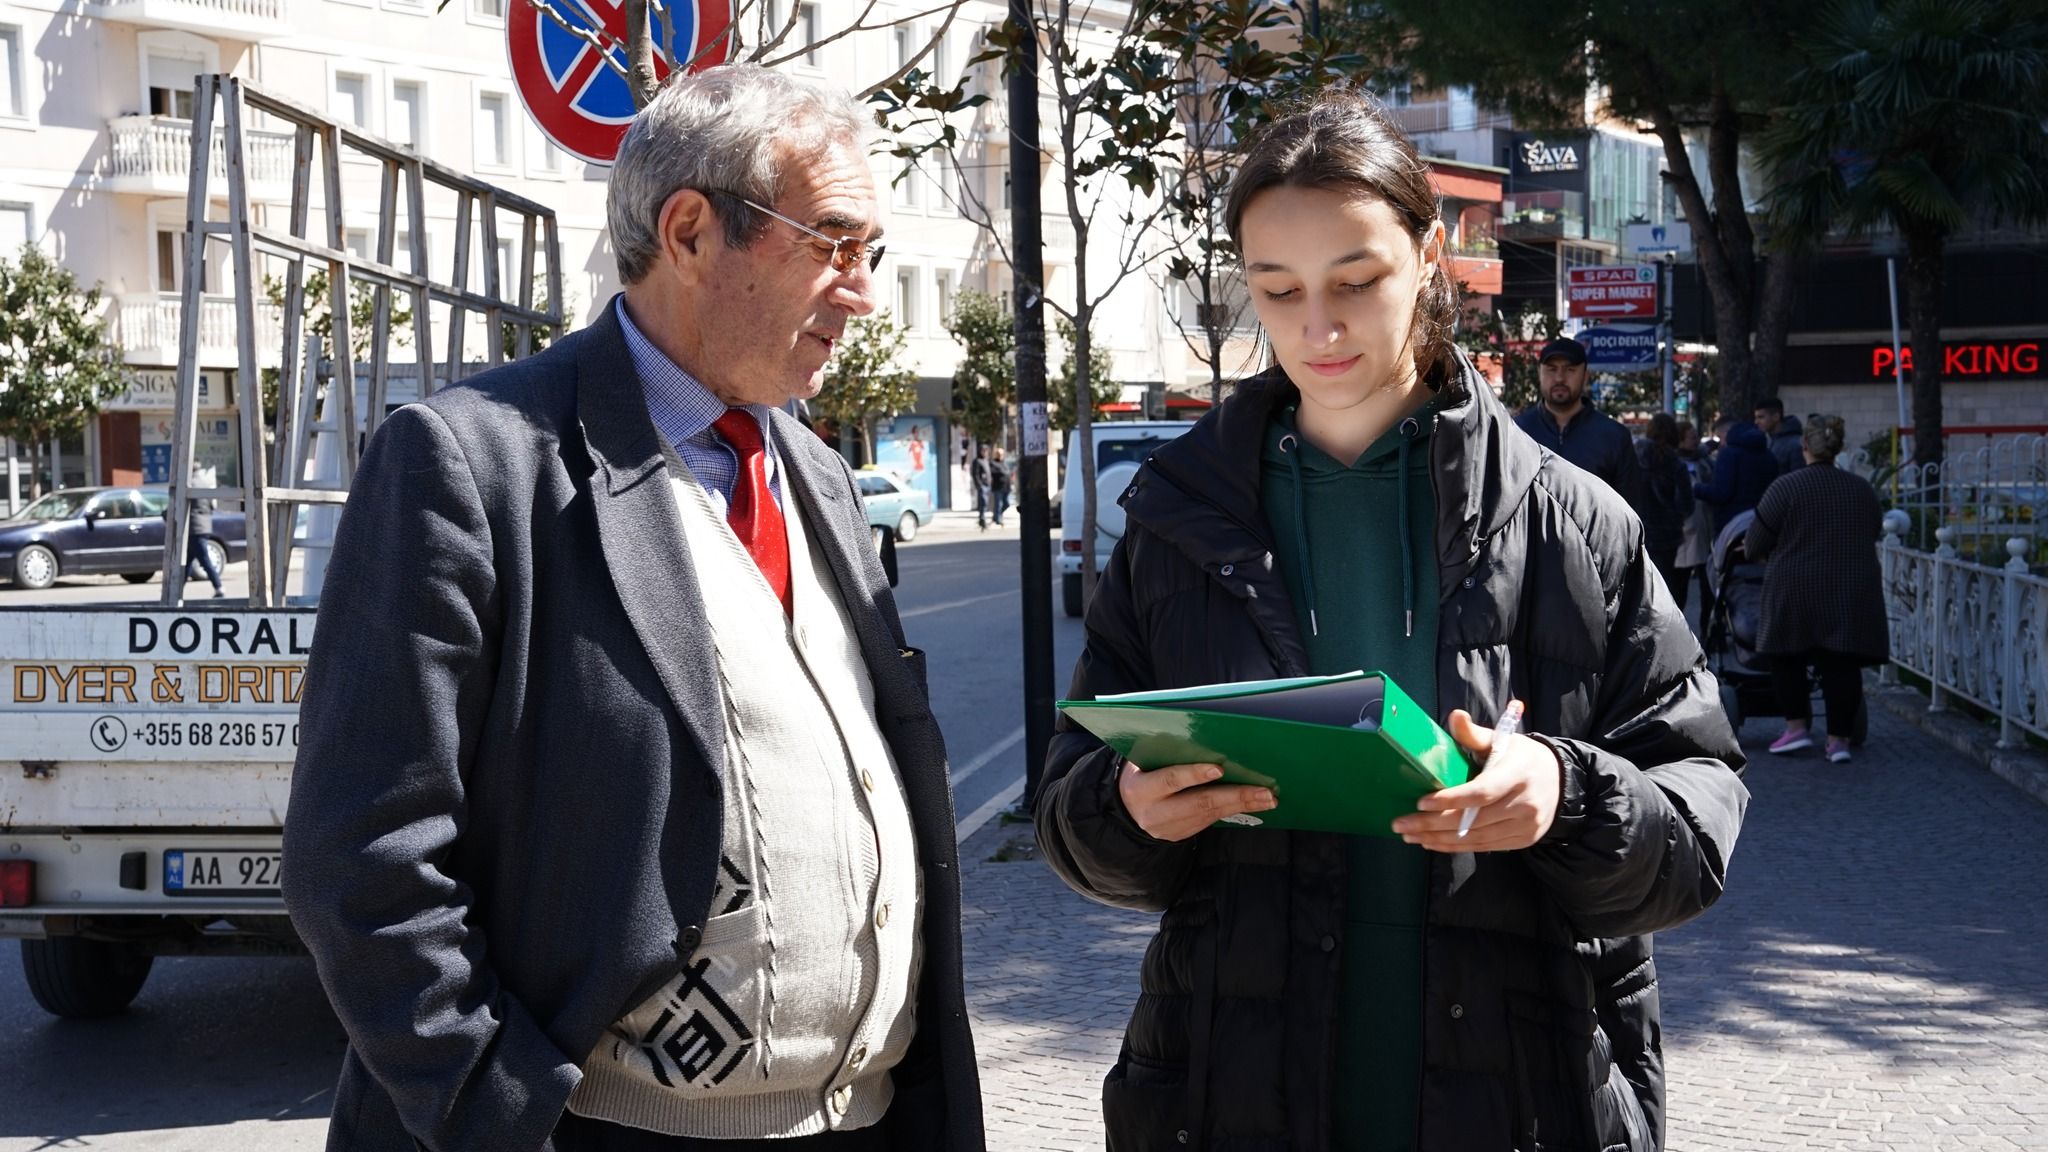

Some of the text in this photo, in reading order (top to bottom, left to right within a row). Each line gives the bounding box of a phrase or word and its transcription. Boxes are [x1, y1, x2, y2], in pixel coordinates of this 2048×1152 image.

[1527, 146, 1578, 165] SAVA
[1583, 270, 1635, 281] SPAR
[1572, 285, 1653, 300] SUPER MARKET
[1593, 335, 1656, 348] BOÇI DENTAL
[1872, 343, 2039, 377] PAKING
[13, 665, 138, 703] DYER
[151, 664, 184, 703] &
[132, 722, 182, 747] +355
[188, 722, 213, 747] 68
[219, 722, 256, 747] 236
[262, 723, 286, 747] 57
[190, 856, 222, 885] AA
